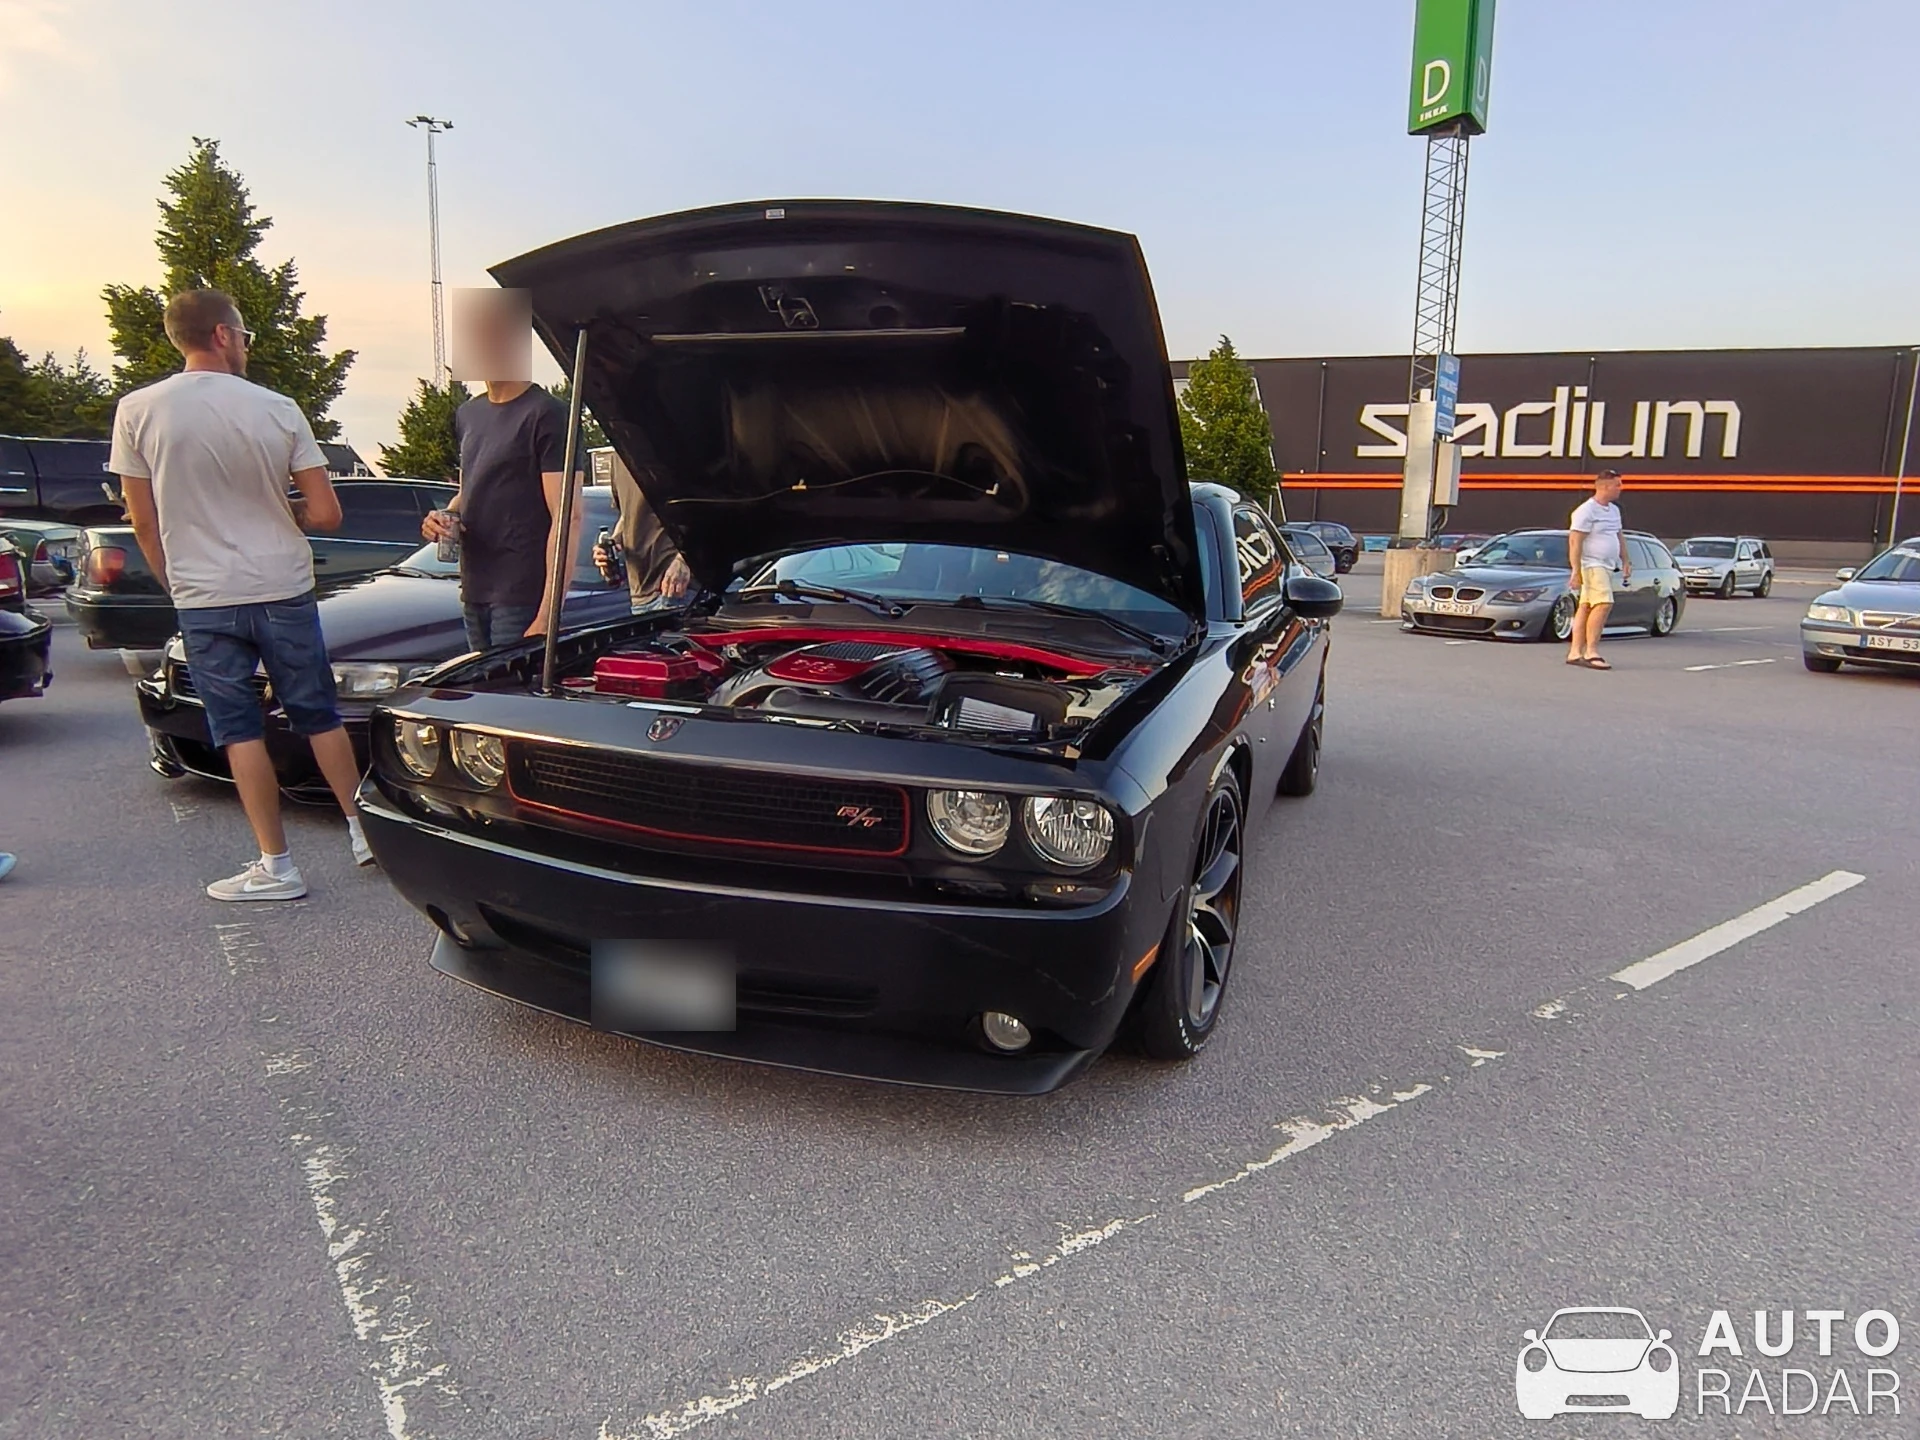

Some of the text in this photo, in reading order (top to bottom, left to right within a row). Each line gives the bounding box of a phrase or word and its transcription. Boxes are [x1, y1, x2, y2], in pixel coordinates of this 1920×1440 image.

[1422, 60, 1451, 107] D
[1356, 385, 1741, 458] sadium
[1869, 636, 1893, 647] ASY
